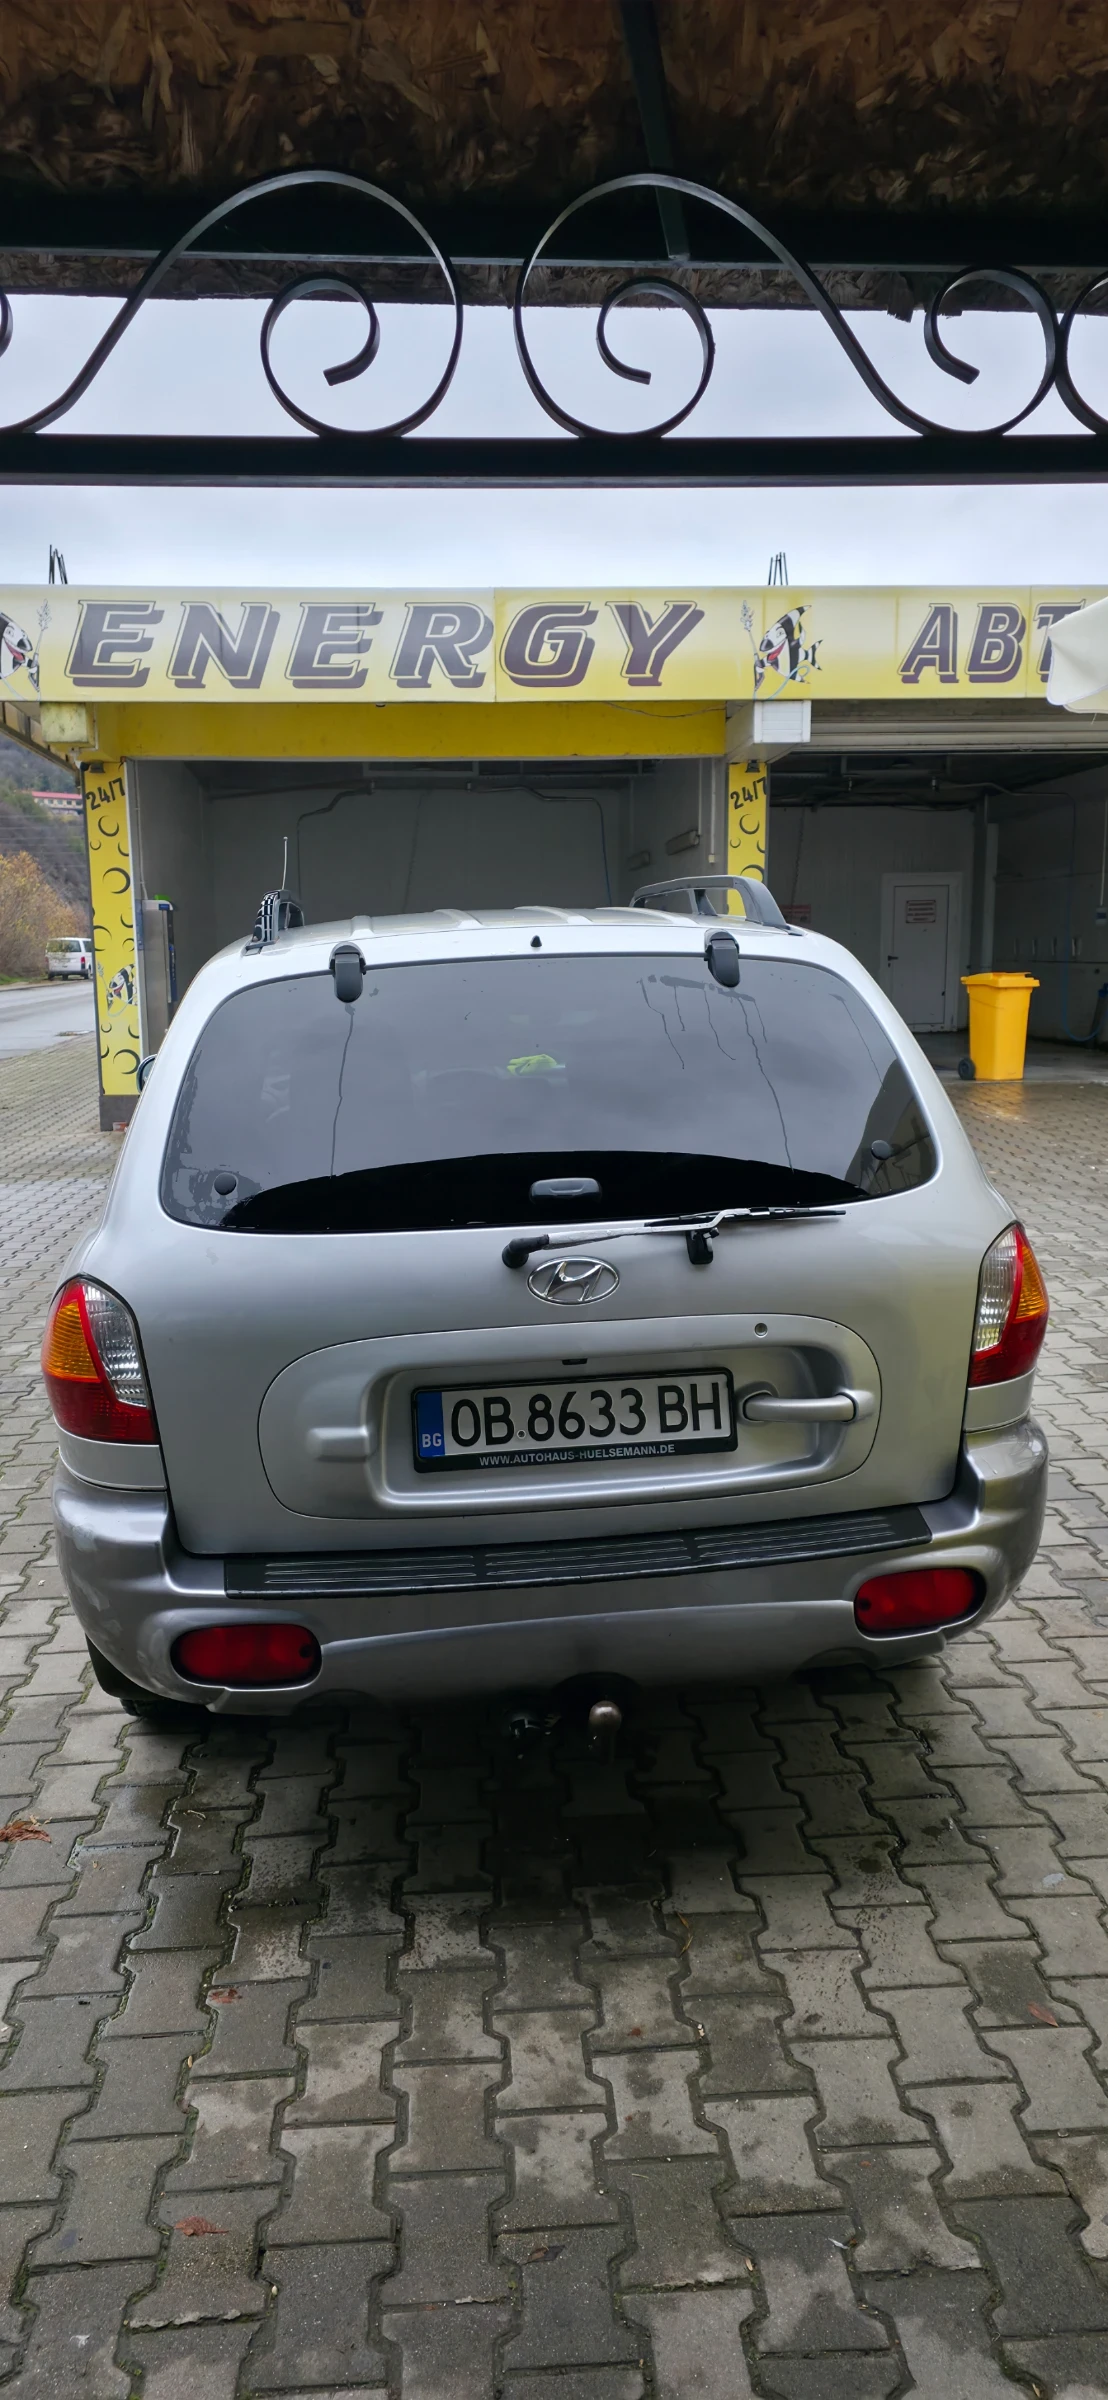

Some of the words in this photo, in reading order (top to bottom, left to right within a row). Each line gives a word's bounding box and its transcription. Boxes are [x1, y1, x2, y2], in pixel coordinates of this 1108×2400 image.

[65, 600, 704, 689] ENERGY
[85, 777, 126, 811] 24/7
[730, 777, 767, 810] 24/7
[657, 1382, 722, 1434] BH
[421, 1432, 442, 1448] BG
[479, 1443, 676, 1466] WWW.AUTOHAUS-HUELSEMANN.DE
